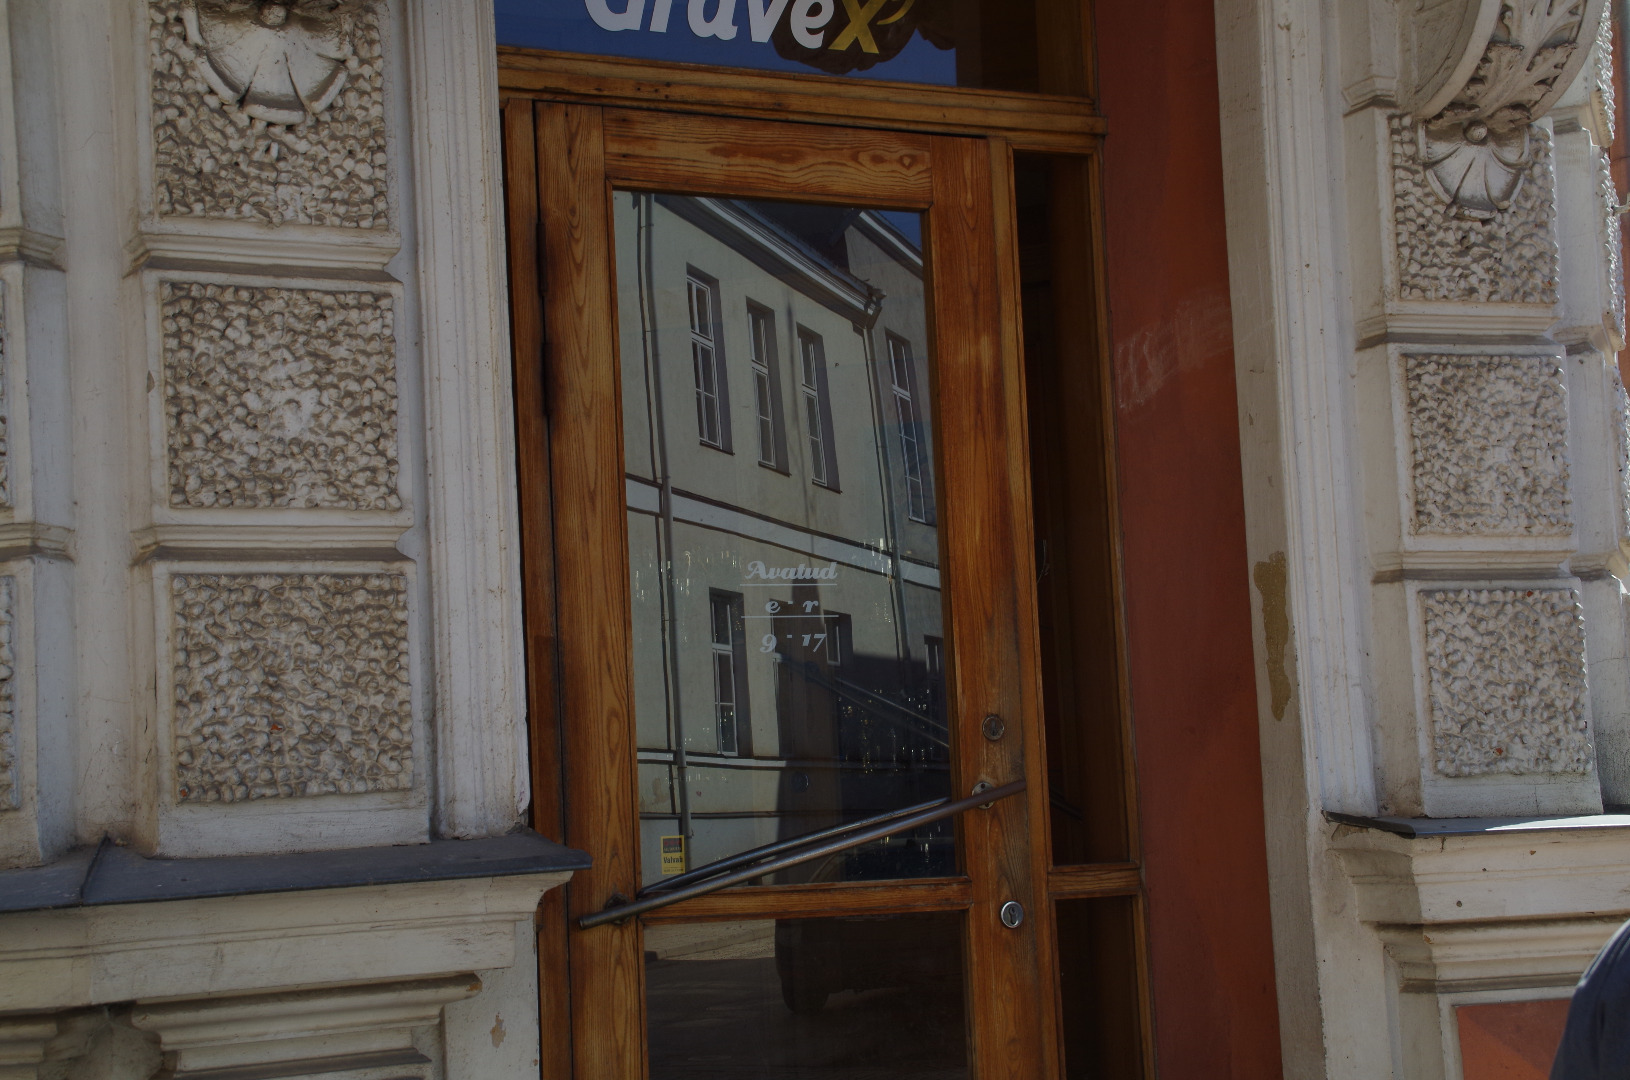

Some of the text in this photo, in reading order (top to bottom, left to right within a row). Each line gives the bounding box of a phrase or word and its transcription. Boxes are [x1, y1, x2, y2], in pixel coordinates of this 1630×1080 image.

[745, 560, 838, 580] Avatud
[765, 601, 780, 613] e
[803, 600, 819, 612] r
[760, 633, 777, 653] 9
[801, 633, 827, 653] 17
